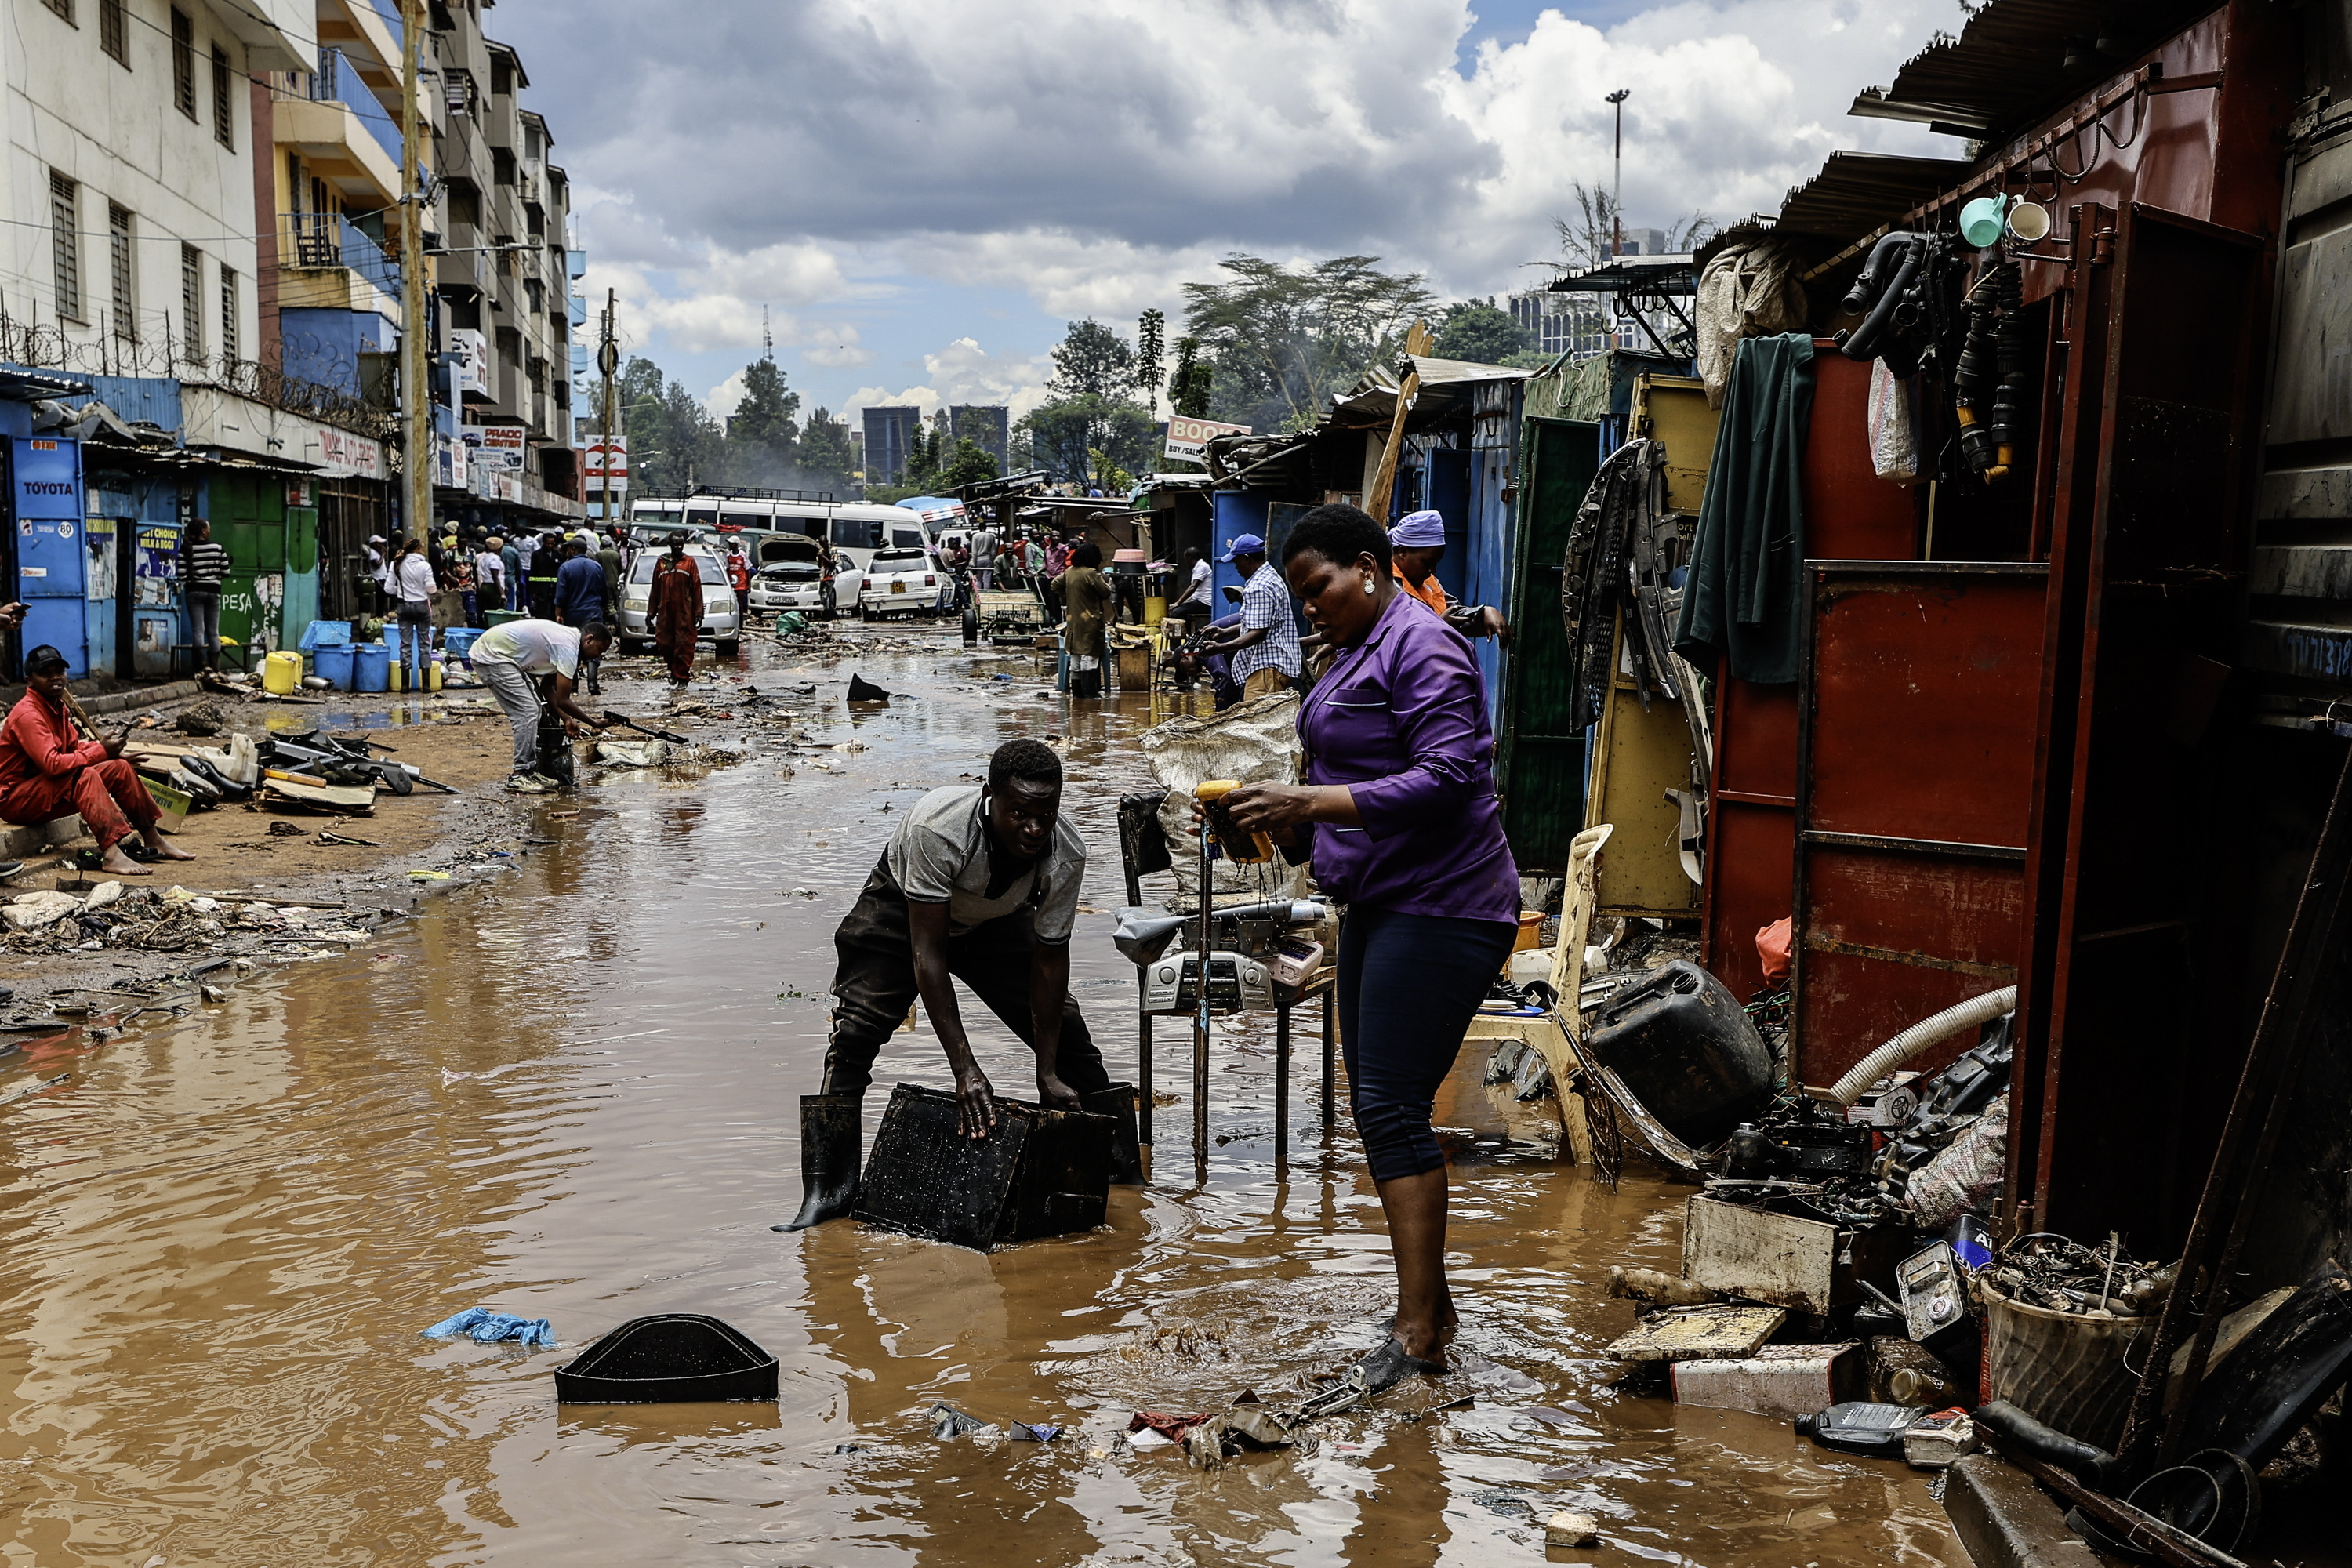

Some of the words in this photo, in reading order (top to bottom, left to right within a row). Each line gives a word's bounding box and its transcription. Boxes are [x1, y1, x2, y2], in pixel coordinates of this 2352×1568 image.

[485, 428, 522, 438] PRADO
[484, 438, 521, 448] CENTER
[24, 482, 73, 495] TOYOTA
[60, 524, 71, 533] 80
[154, 528, 177, 539] CHOICE
[1678, 532, 1691, 541] hell
[140, 538, 154, 548] MILK
[161, 539, 174, 550] EGGS
